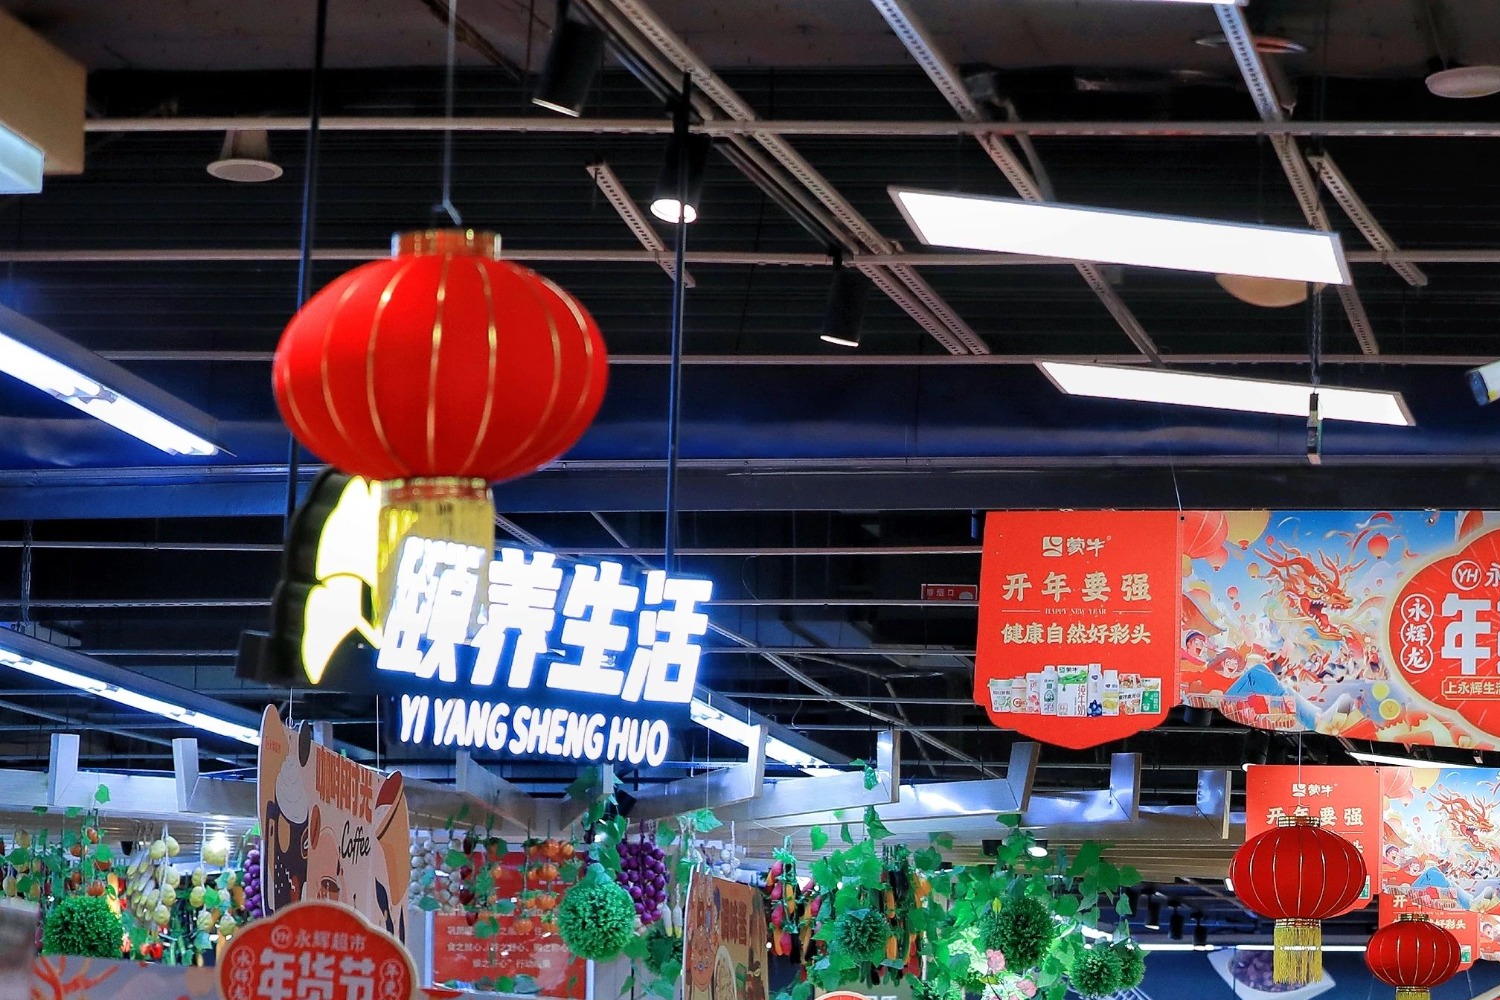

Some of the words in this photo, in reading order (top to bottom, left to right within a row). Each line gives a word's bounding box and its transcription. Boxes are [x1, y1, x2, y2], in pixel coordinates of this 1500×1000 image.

[1066, 537, 1105, 557] 蒙牛
[1002, 571, 1152, 603] 开年要强
[1457, 566, 1479, 582] YH
[376, 536, 713, 703] 颐养生活
[1045, 607, 1067, 615] HAPPY
[1071, 607, 1085, 615] NEW
[1088, 607, 1107, 615] YEAR
[1001, 621, 1152, 646] 健康自然好彩头
[1405, 598, 1429, 669] 永辉龙
[400, 693, 429, 745] YI
[433, 697, 511, 751] YANG
[508, 705, 604, 761] SHENG
[608, 715, 670, 767] HUO
[1308, 784, 1333, 797] 蒙牛
[341, 820, 372, 864] Coffee
